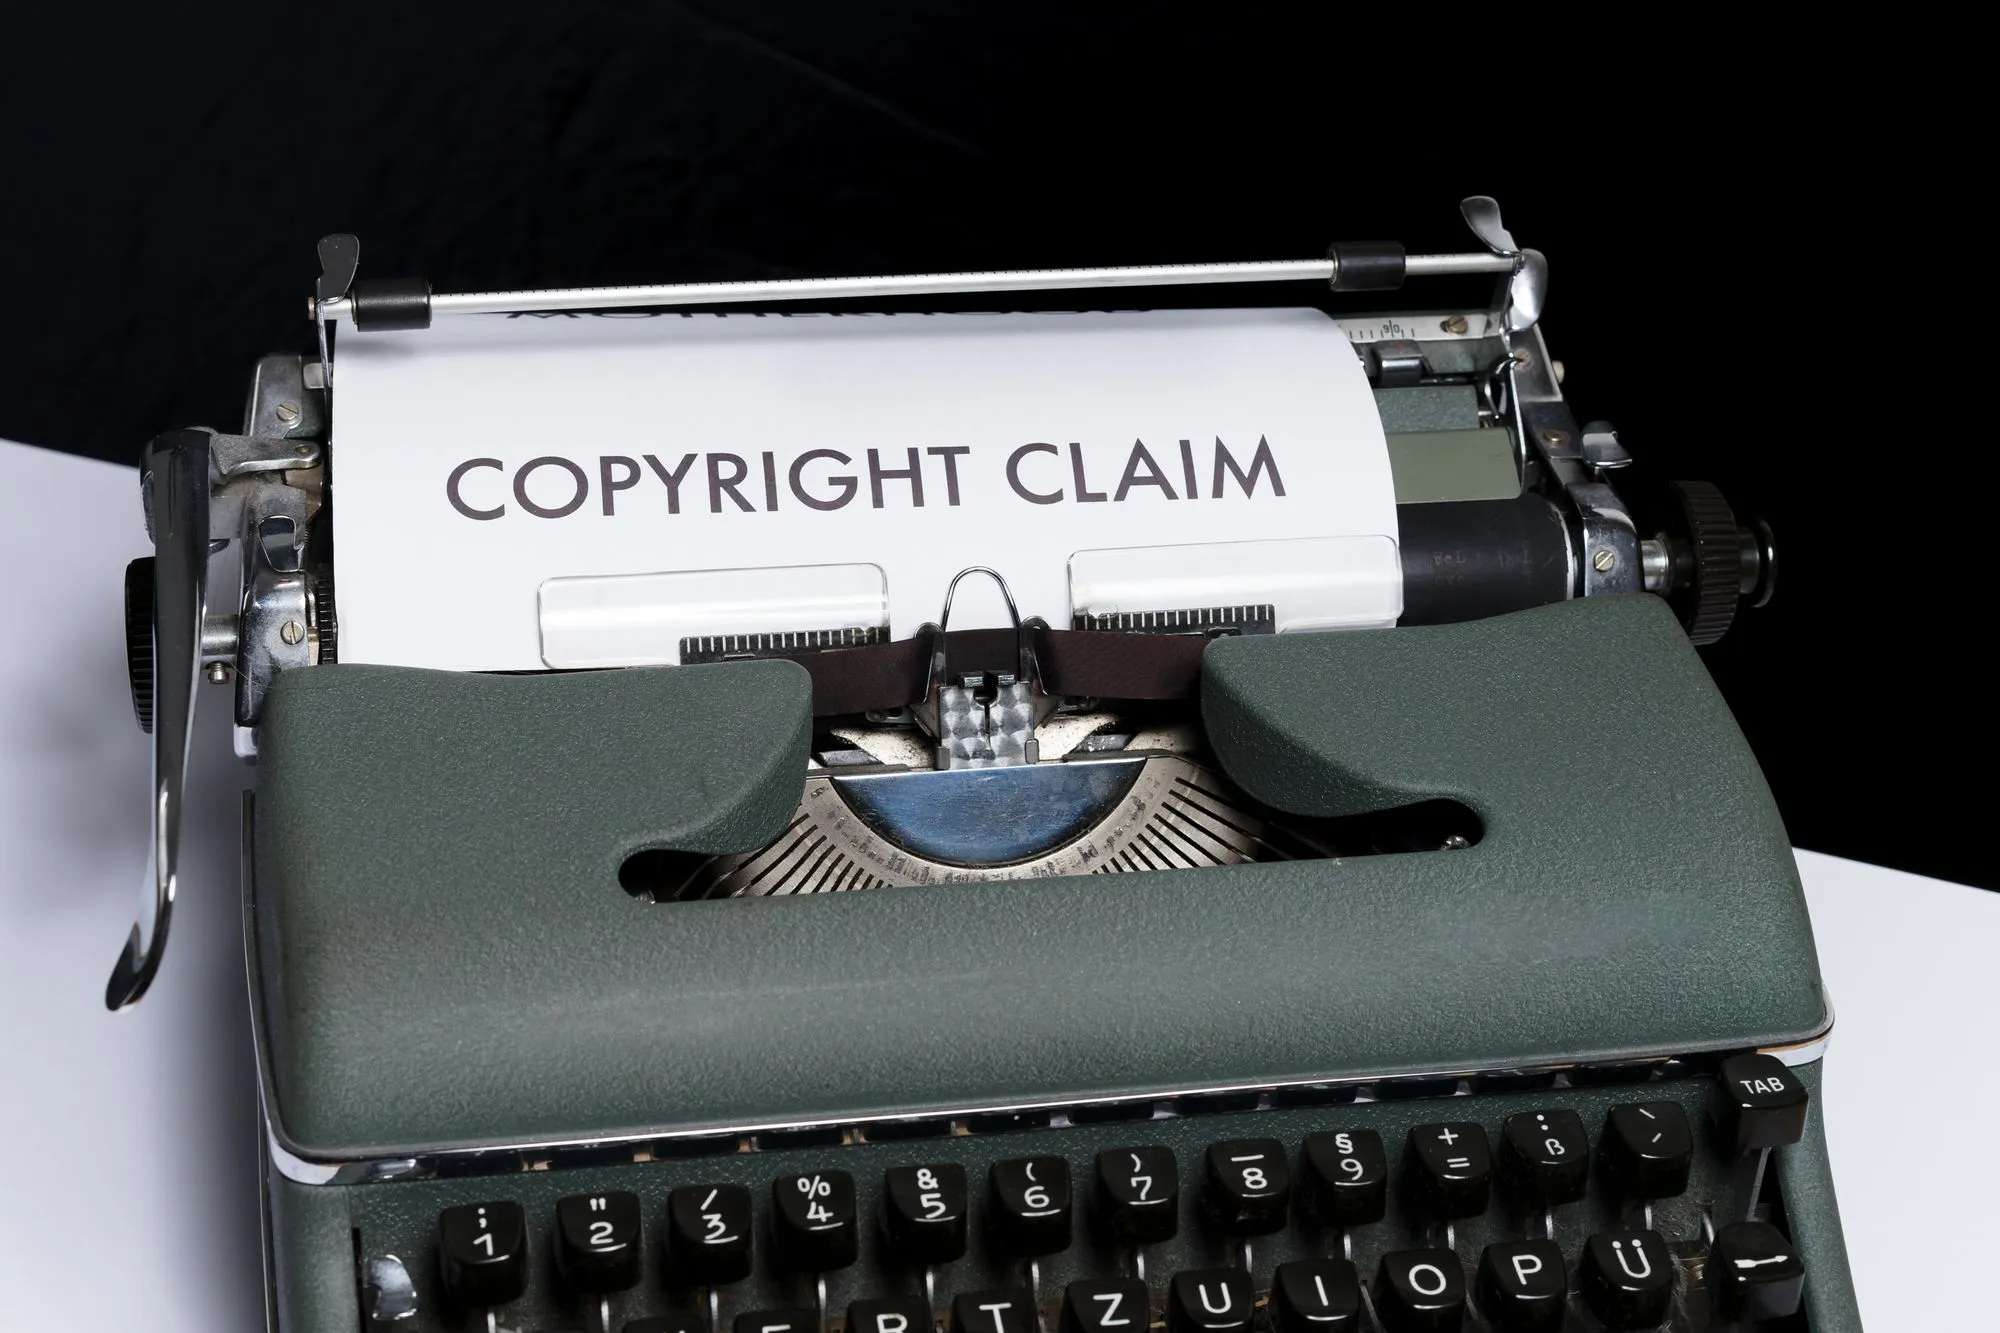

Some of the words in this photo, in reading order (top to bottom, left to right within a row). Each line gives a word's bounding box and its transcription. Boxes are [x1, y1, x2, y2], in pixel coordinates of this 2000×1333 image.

[446, 445, 971, 521] COPYRIGHT
[1005, 434, 1286, 505] CLAIM
[1739, 1077, 1785, 1095] TAB
[916, 1168, 939, 1190] &
[1242, 1167, 1268, 1189] 8
[1340, 1158, 1363, 1181] 9
[1024, 1185, 1050, 1208] 6
[1130, 1175, 1152, 1201] 7
[806, 1201, 834, 1223] 4
[920, 1192, 946, 1219] 5
[589, 1221, 613, 1245] 2
[702, 1213, 726, 1240] 3
[473, 1232, 494, 1256] 1
[1512, 1254, 1542, 1285] P
[1612, 1239, 1651, 1279] Ü
[1314, 1275, 1329, 1306] I
[1408, 1264, 1447, 1296] O
[1093, 1293, 1130, 1326] Z
[1198, 1282, 1232, 1314] U
[979, 1302, 1012, 1333] T
